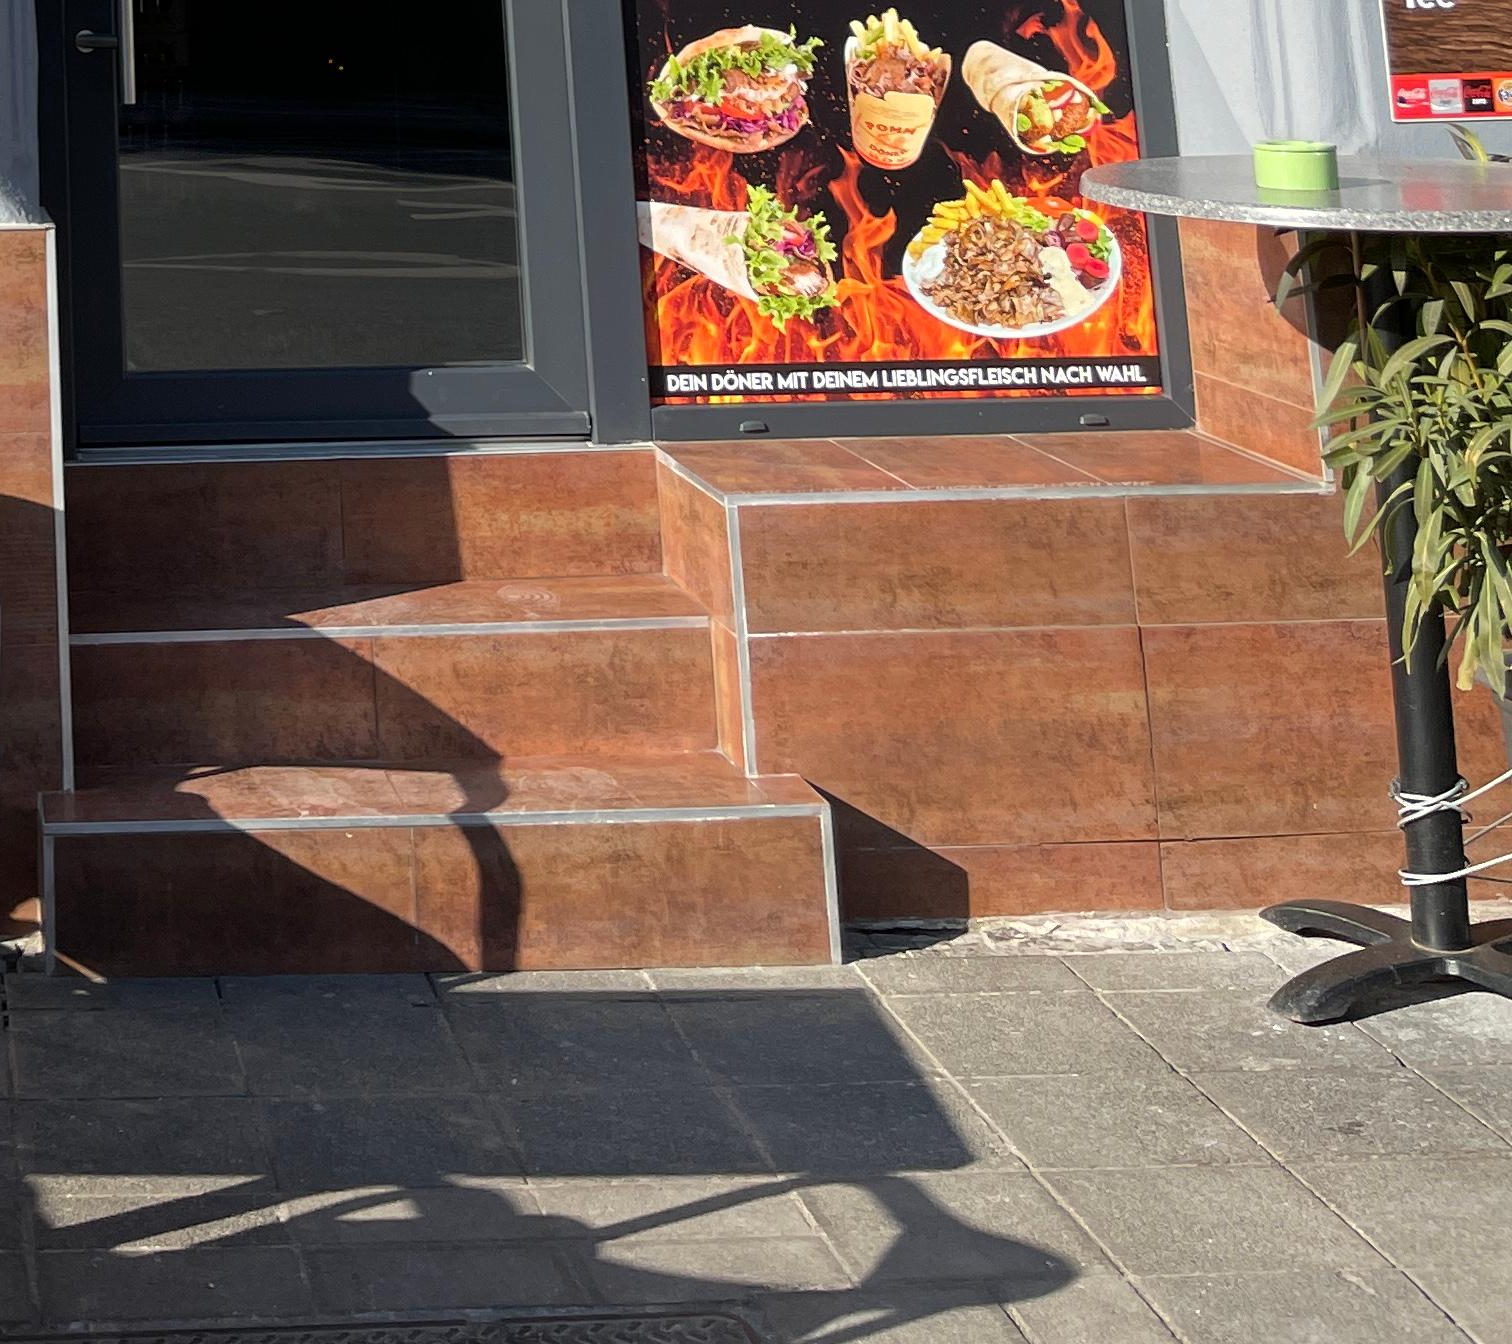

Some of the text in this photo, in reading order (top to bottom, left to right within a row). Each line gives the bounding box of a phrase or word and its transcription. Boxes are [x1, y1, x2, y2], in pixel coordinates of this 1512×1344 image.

[667, 364, 1147, 392] DEIN DÖNER MIT DEINEM LIEBLINGSFLEISCH NACH WAHL
